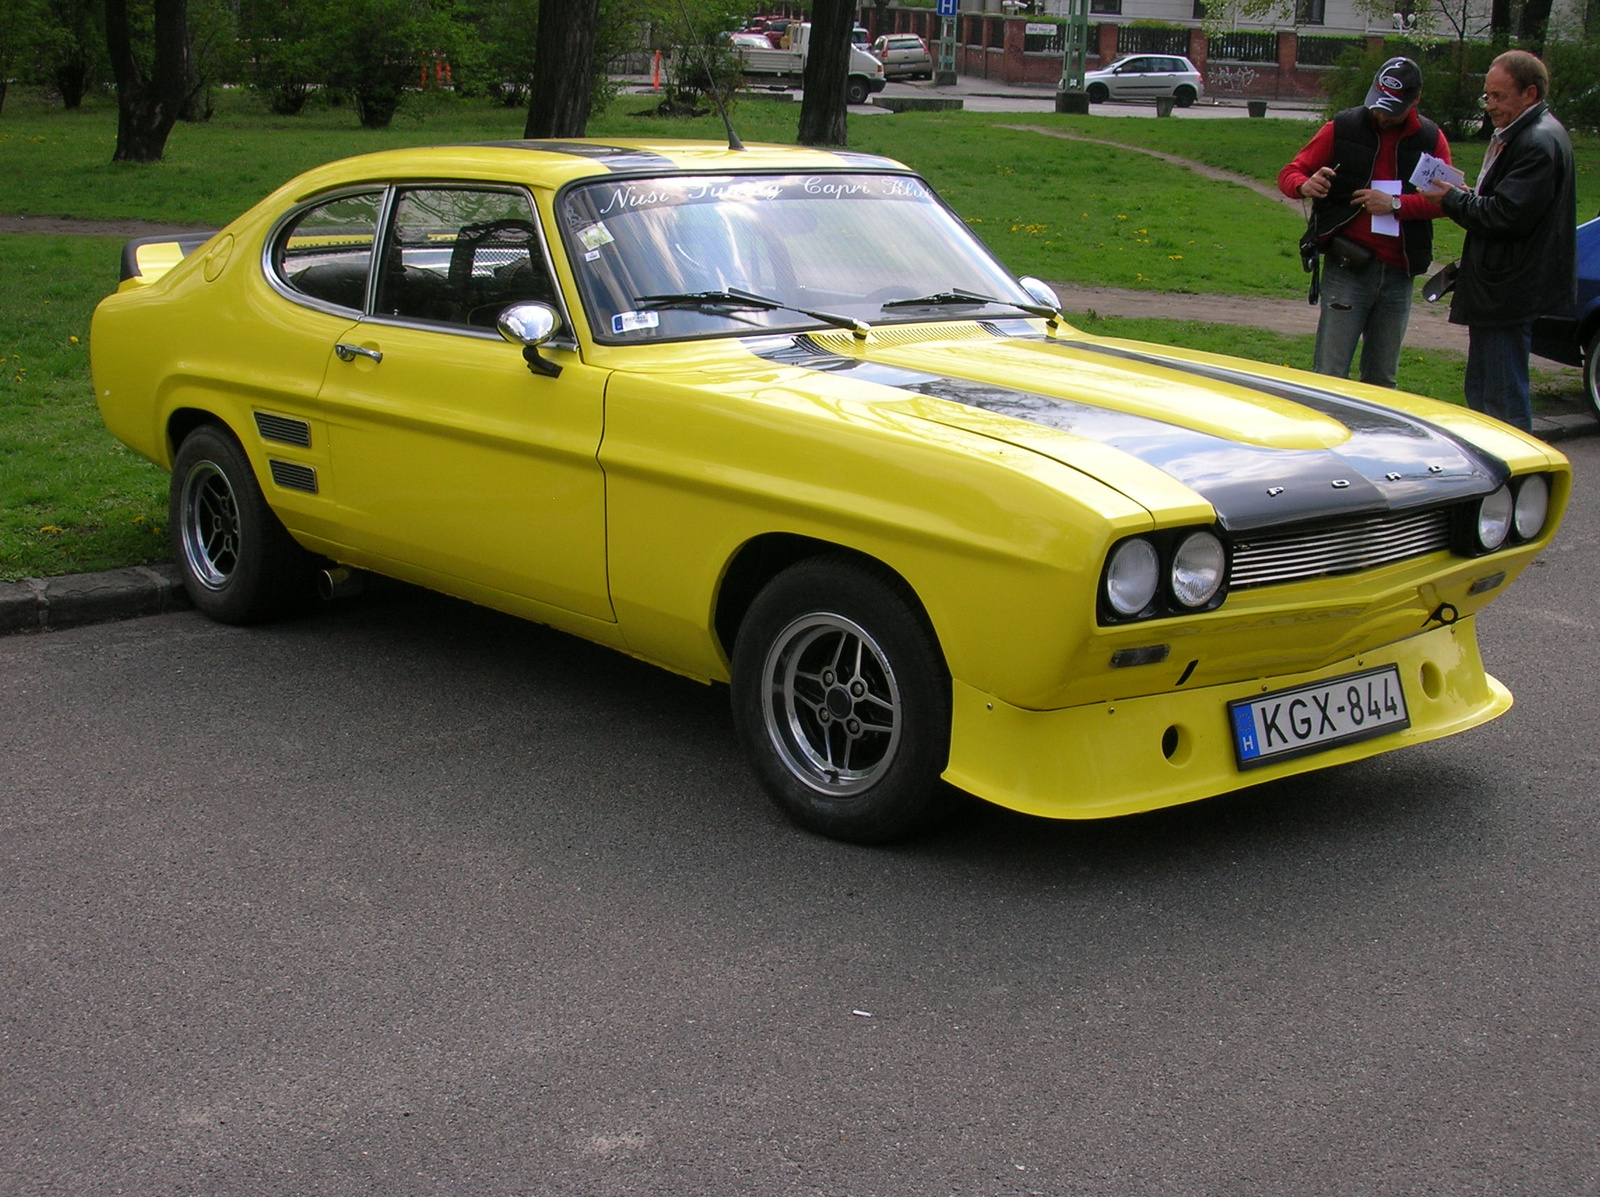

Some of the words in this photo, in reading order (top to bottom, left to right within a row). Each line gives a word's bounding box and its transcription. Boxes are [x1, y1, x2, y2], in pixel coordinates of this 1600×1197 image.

[600, 186, 669, 214] Nusi
[688, 182, 782, 200] Tung
[796, 176, 870, 200] Capri
[1266, 464, 1443, 498] FORD
[1260, 677, 1398, 748] KGX-844
[1242, 734, 1254, 752] H
